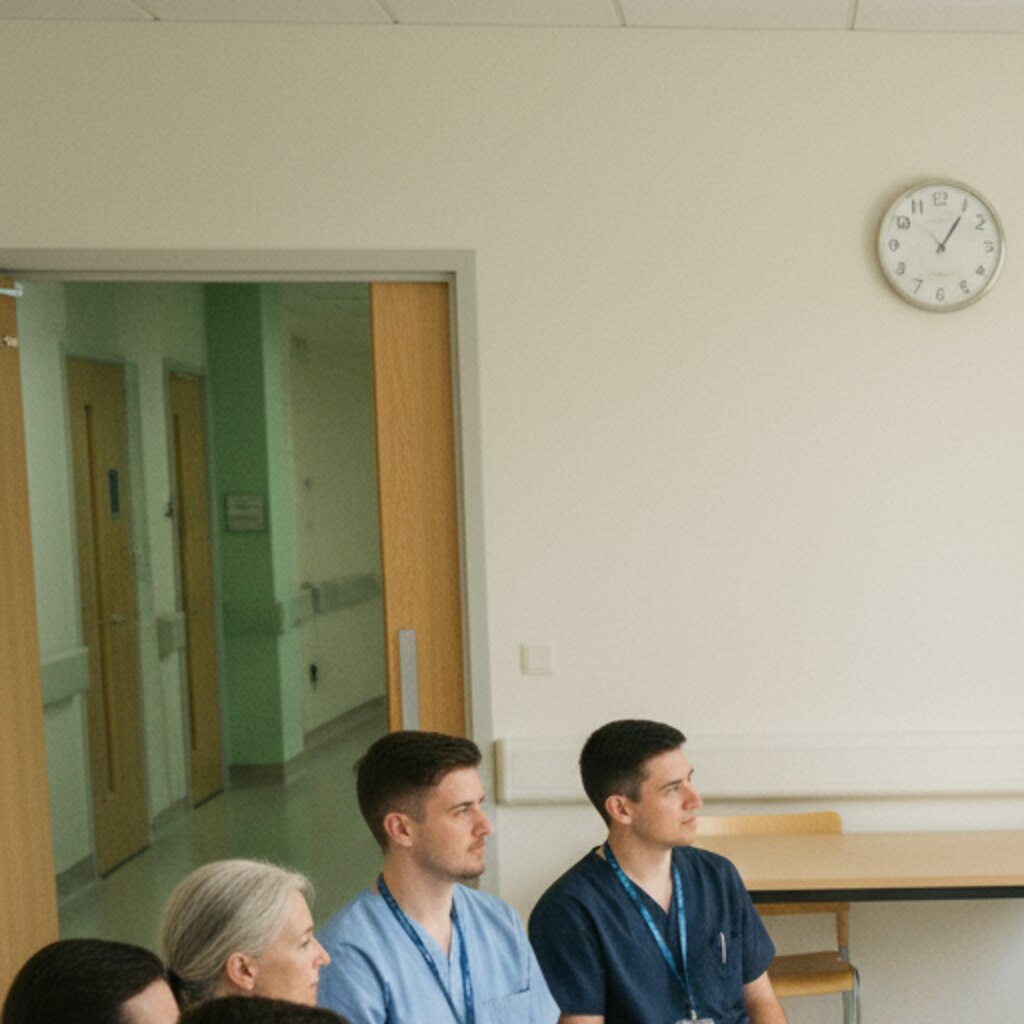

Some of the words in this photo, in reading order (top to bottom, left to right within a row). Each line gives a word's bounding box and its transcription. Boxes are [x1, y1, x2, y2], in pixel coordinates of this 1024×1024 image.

[911, 199, 924, 214] 11
[974, 214, 986, 230] 2
[912, 277, 924, 295] 7
[936, 287, 945, 302] 6
